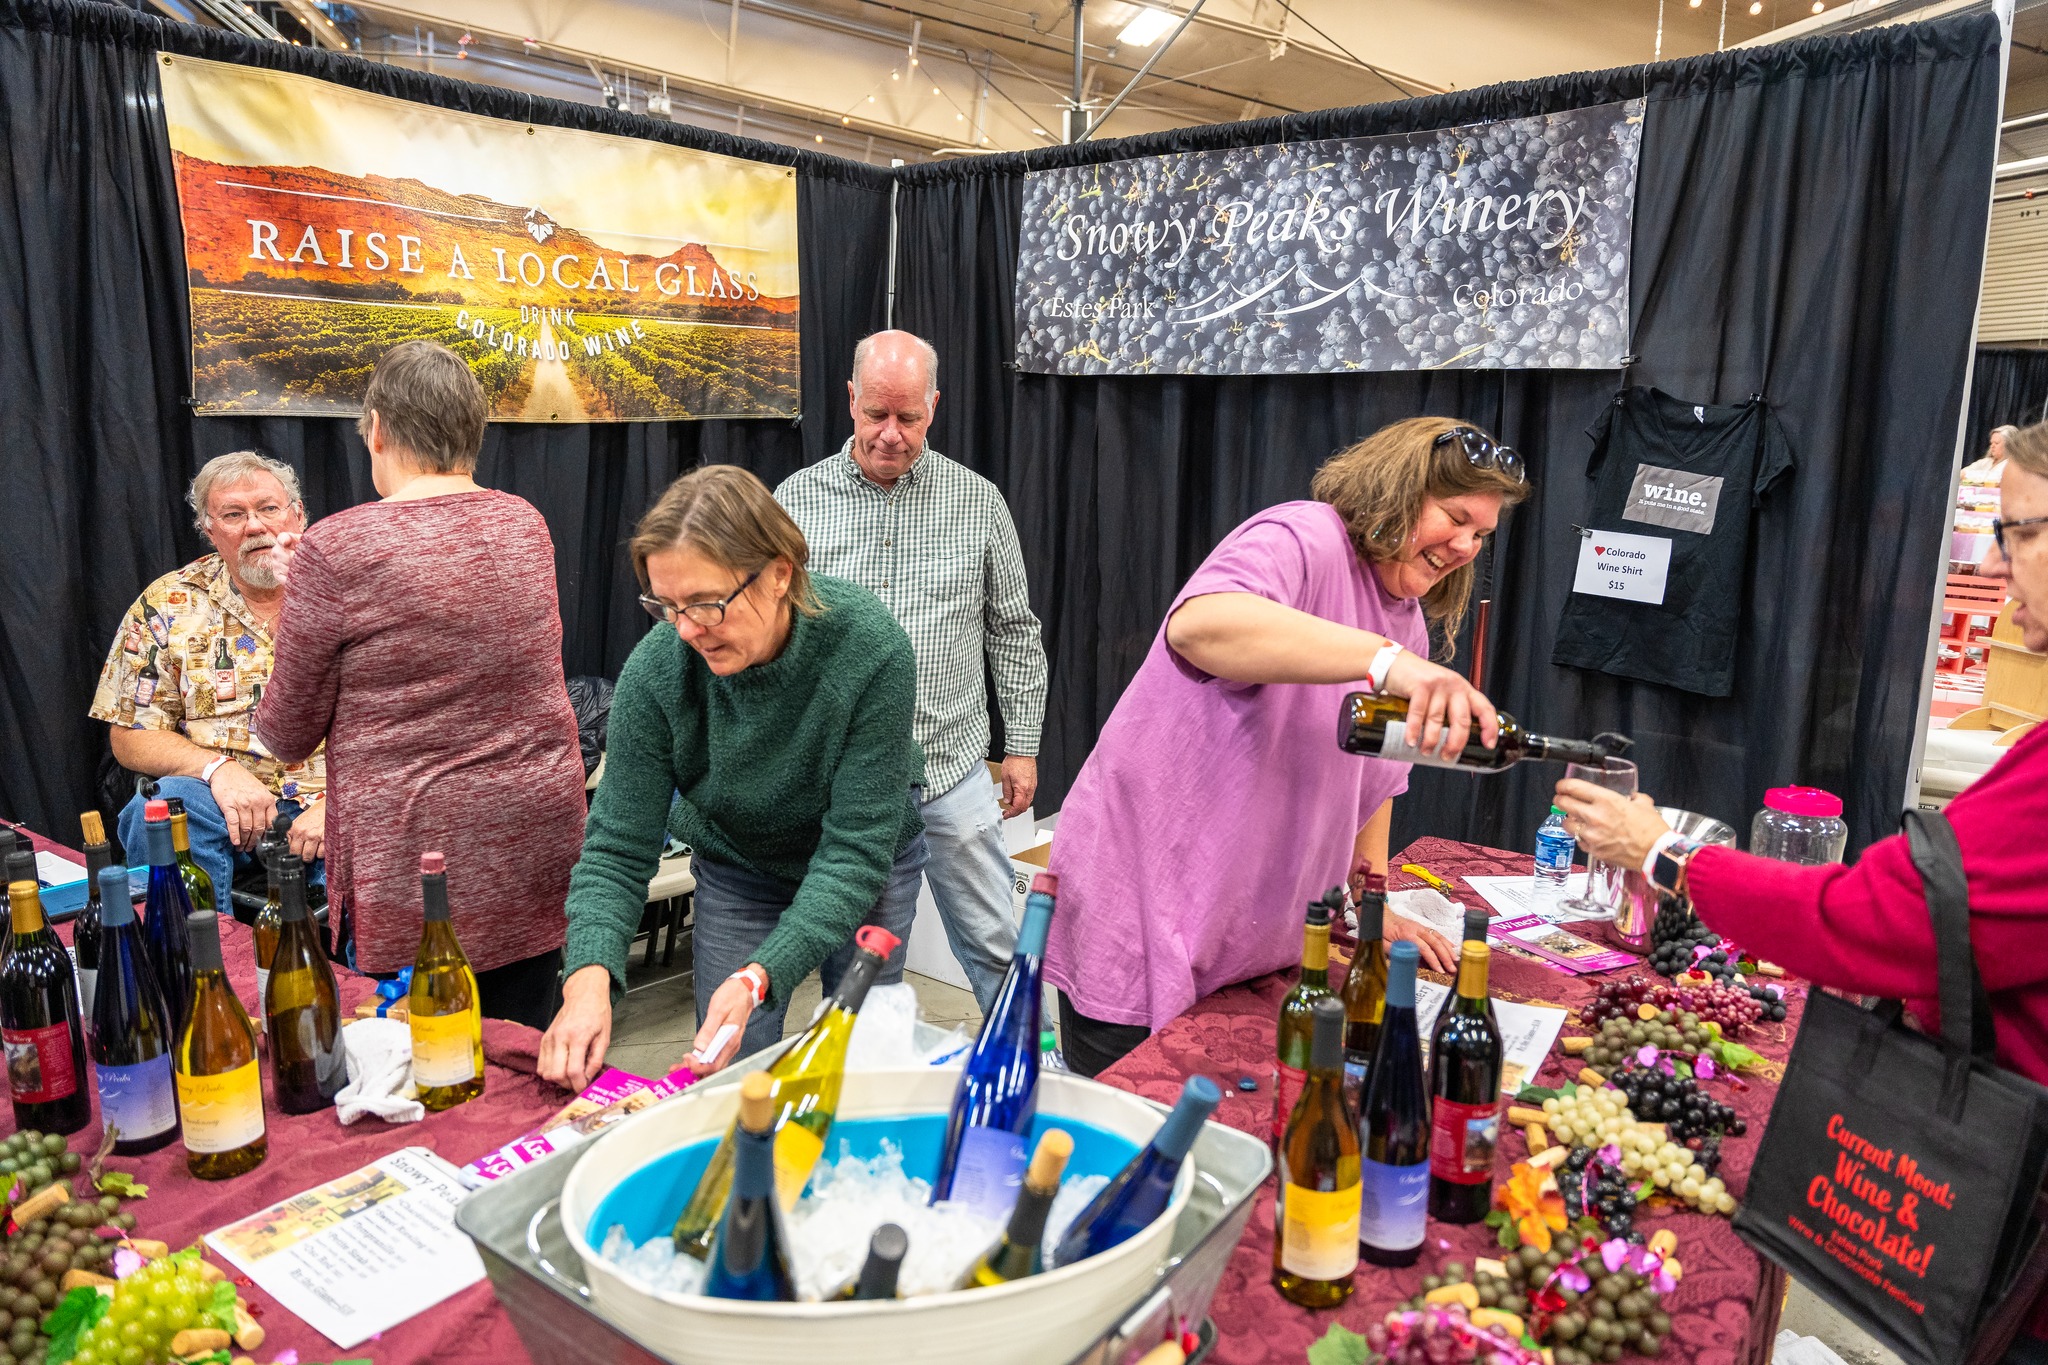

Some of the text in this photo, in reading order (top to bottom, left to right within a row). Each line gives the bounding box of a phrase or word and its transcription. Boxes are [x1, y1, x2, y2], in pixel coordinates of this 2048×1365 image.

[1057, 176, 1585, 268] Snowy Peaks Winery
[247, 219, 761, 301] RAISE A LOCAL GLASS
[1049, 297, 1156, 319] Estes Park
[1453, 277, 1584, 308] Colorado
[519, 304, 576, 327] DRINK
[456, 309, 647, 362] COLORADO WINE
[1643, 482, 1707, 508] wine.
[1597, 562, 1643, 576] Wine Shirt
[1606, 547, 1646, 560] Colorado
[1608, 580, 1625, 590] $15
[1494, 916, 1543, 932] Winery
[1826, 1113, 1956, 1210] Current Mood:
[390, 1157, 459, 1208] Snowy Pea
[1834, 1151, 1919, 1232] Wine &
[1807, 1174, 1935, 1279] Chocolate!
